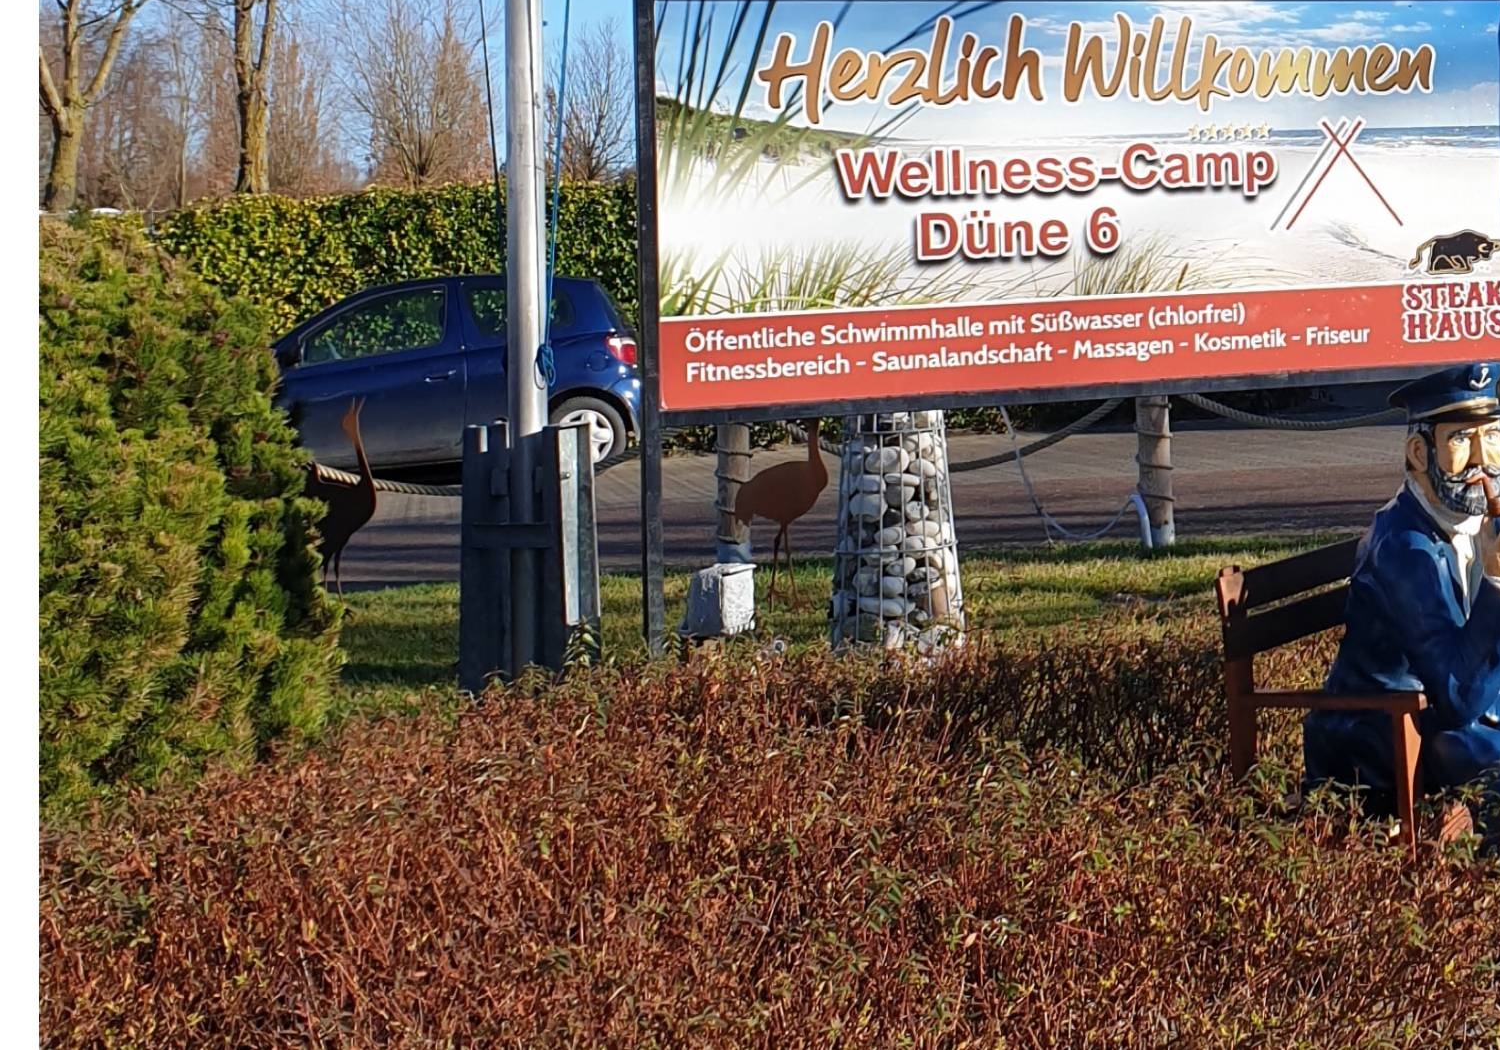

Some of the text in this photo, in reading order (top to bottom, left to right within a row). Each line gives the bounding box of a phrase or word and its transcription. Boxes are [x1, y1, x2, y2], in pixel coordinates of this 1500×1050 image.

[758, 13, 1434, 124] Herzlich Willkommen
[841, 144, 1276, 196] Wellness-Camp
[919, 205, 1119, 259] Düne 6
[685, 302, 1246, 353] Öffentliche Schwimmhalle mit Süßwasser (chlorfrei)
[686, 353, 850, 382] Fitnessbereich
[872, 341, 1053, 372] Saunalandschaft
[1073, 339, 1174, 361] Massagen
[1194, 327, 1287, 352] Kosmetik
[1306, 326, 1371, 346] Friseur
